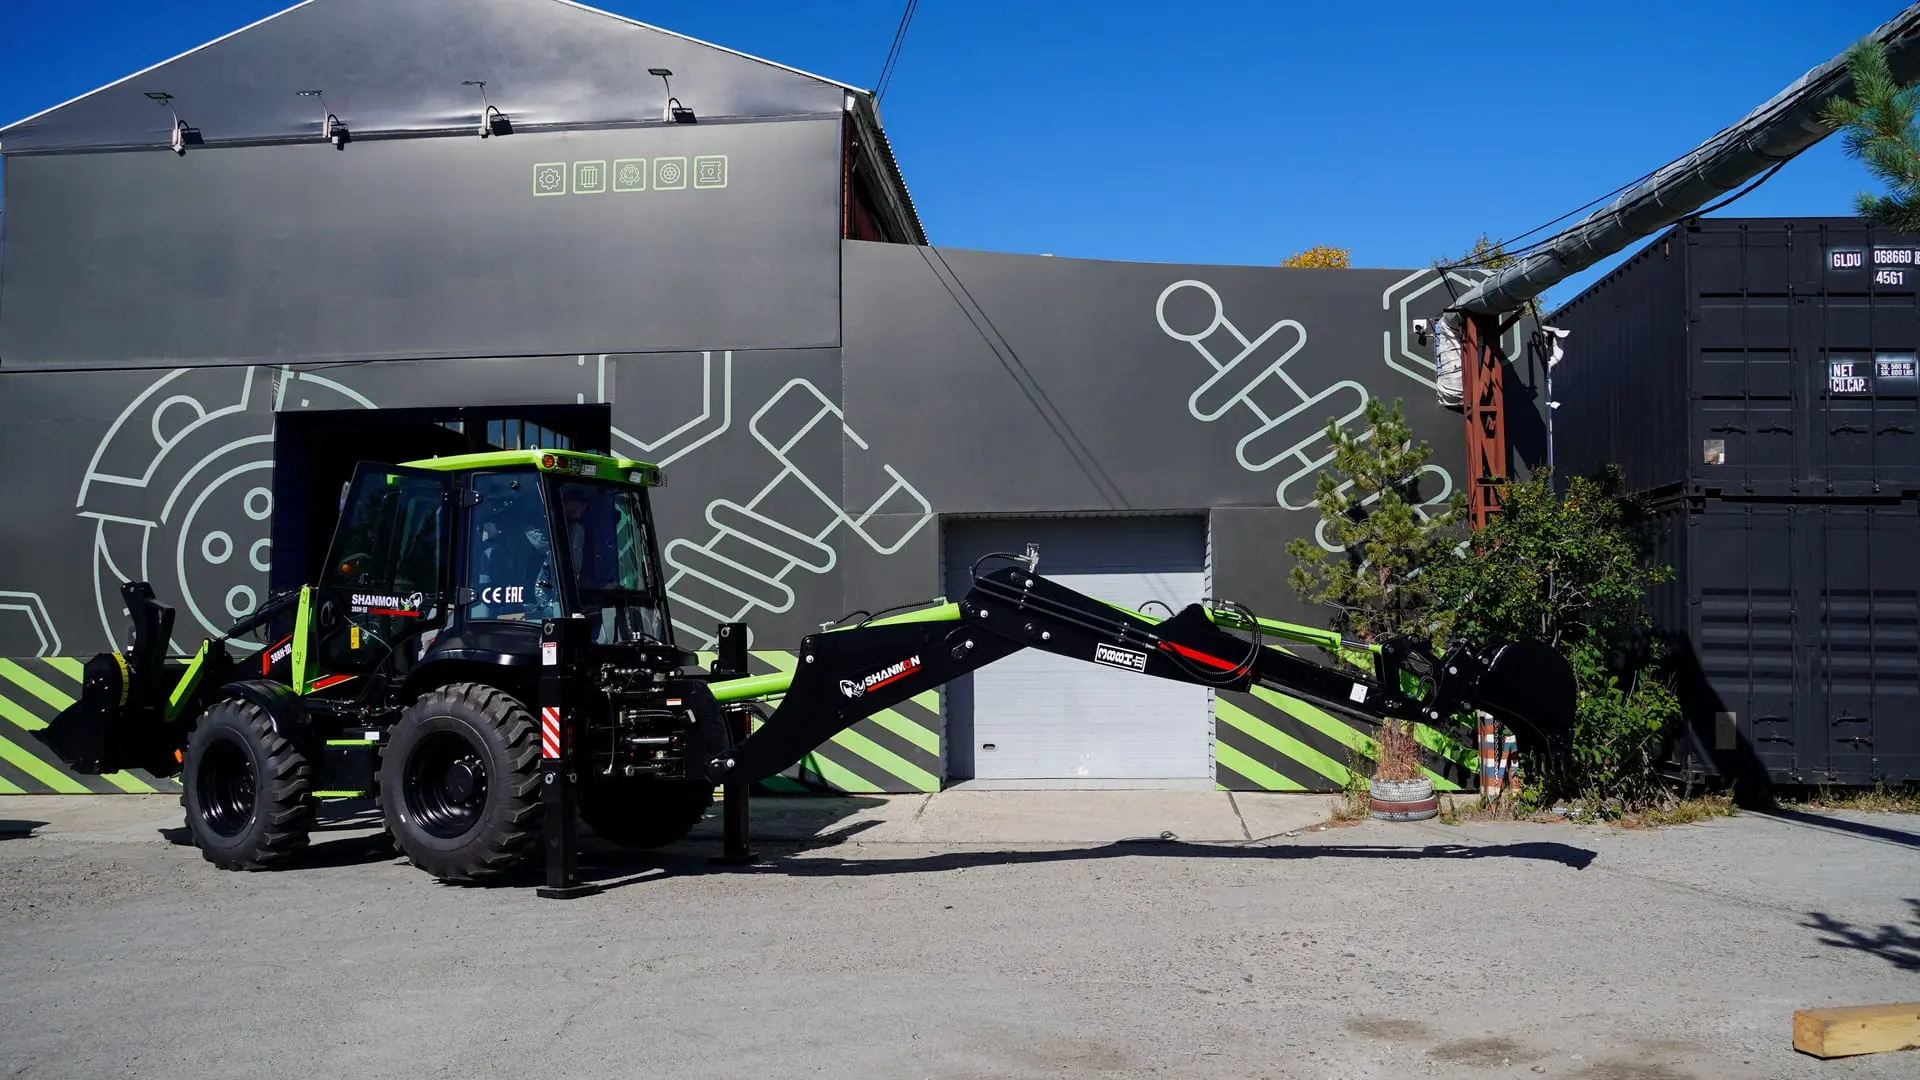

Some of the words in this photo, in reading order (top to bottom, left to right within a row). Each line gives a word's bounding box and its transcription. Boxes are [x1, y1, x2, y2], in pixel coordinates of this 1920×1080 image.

[1834, 253, 1861, 267] GLDU
[1874, 250, 1911, 264] 068660
[1876, 271, 1903, 285] 45G1
[1833, 364, 1854, 377] NET
[1833, 379, 1866, 392] CU.CAP.
[351, 593, 399, 608] SHANMON
[481, 587, 502, 604] CE
[865, 655, 921, 687] SHANMON
